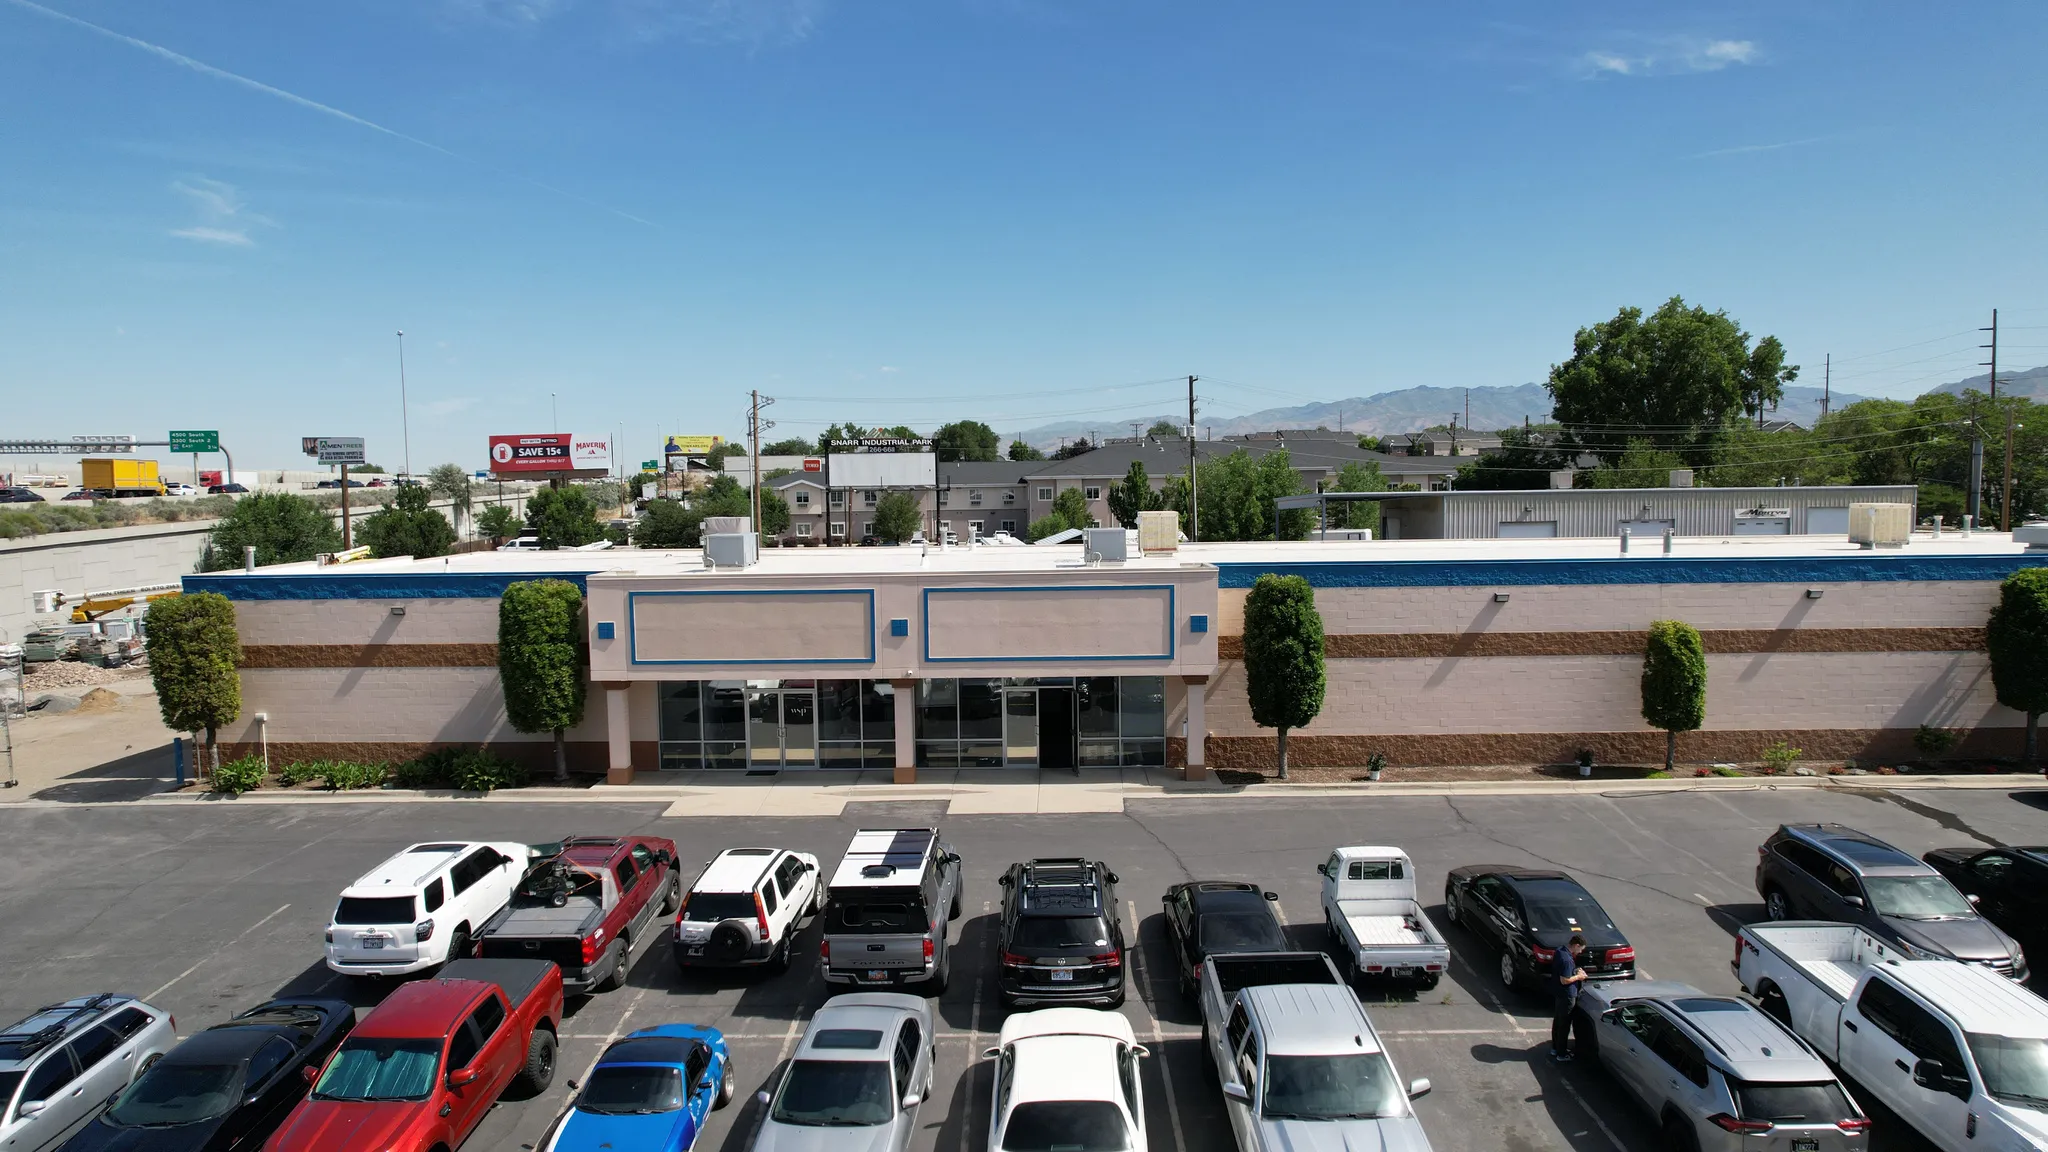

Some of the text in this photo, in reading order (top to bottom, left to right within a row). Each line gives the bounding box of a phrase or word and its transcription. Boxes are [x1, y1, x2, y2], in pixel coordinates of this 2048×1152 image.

[518, 447, 562, 456] SAVE 15¢
[576, 442, 606, 452] MAVERIK
